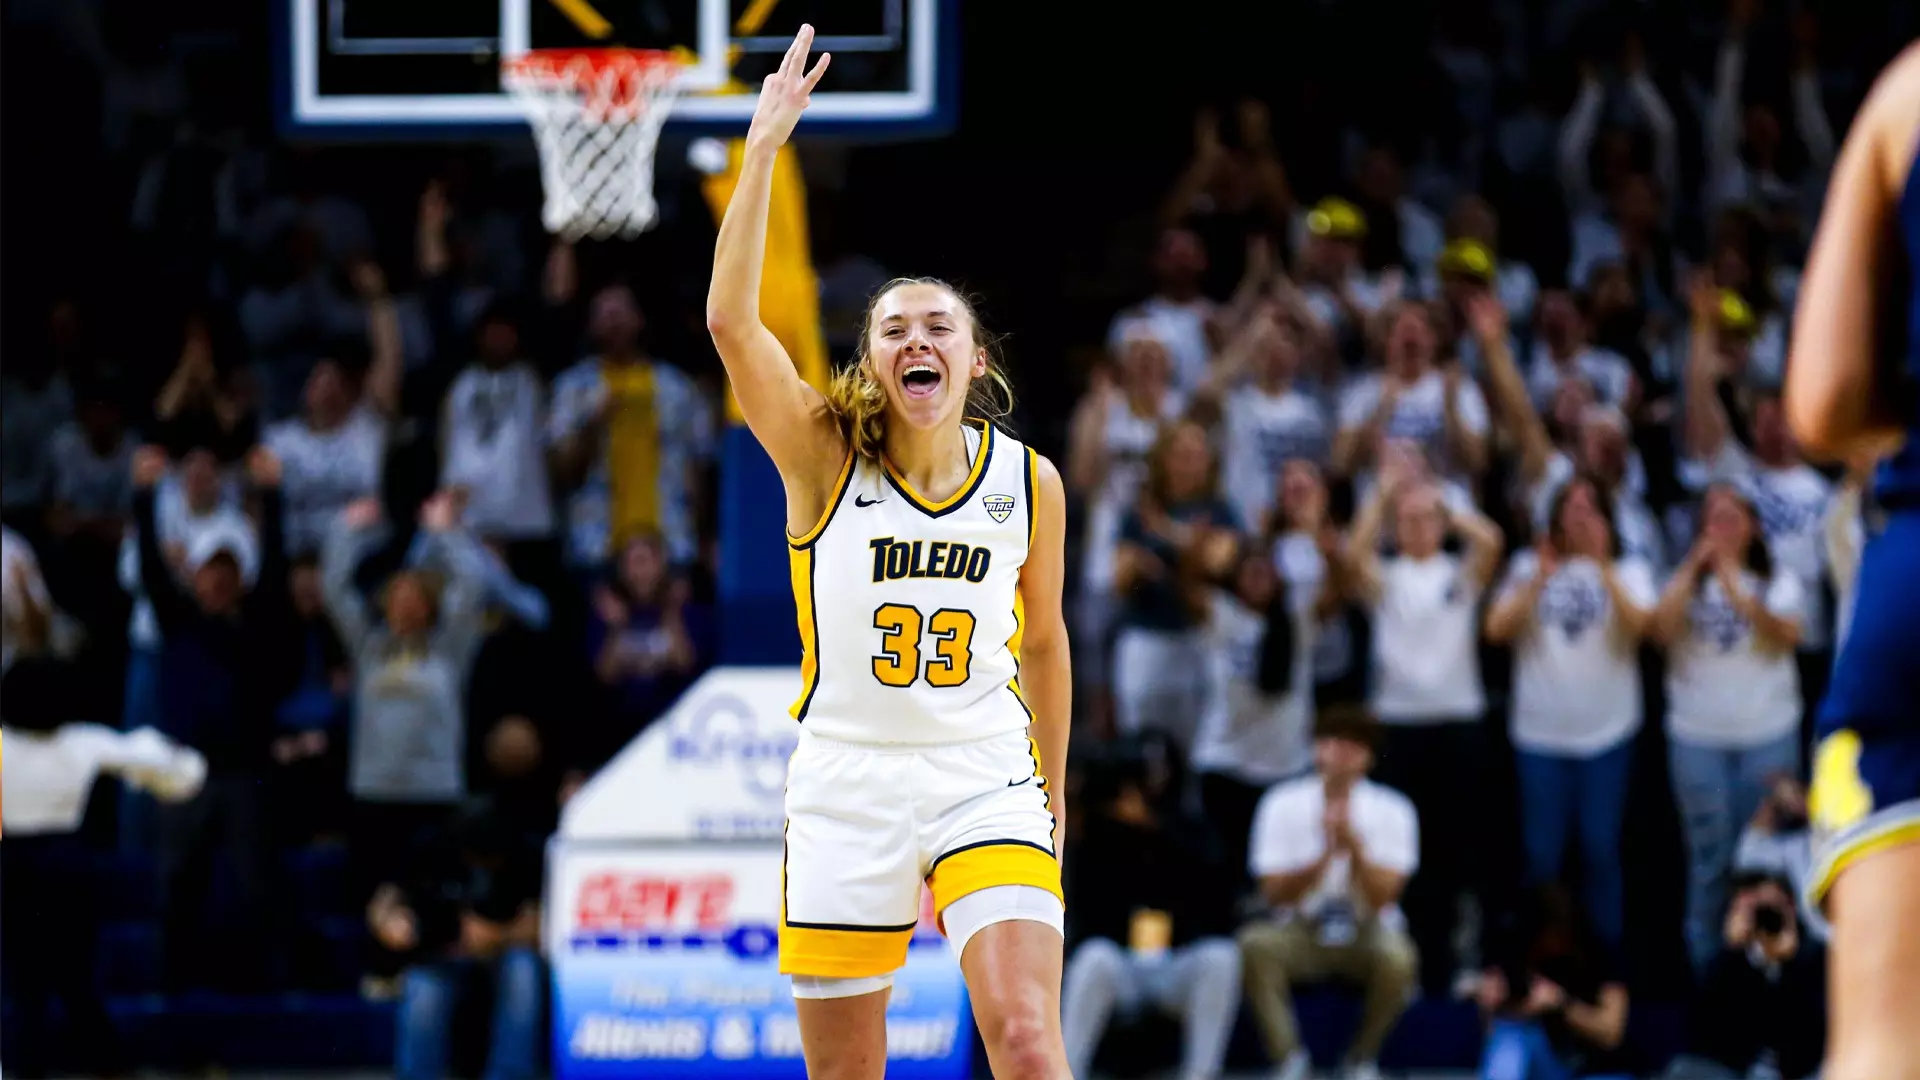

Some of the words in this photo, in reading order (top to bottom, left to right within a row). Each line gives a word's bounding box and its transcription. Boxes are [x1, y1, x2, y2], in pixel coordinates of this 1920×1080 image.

[986, 502, 1014, 511] MAC
[869, 536, 992, 584] TOLEDO
[871, 602, 977, 688] 33
